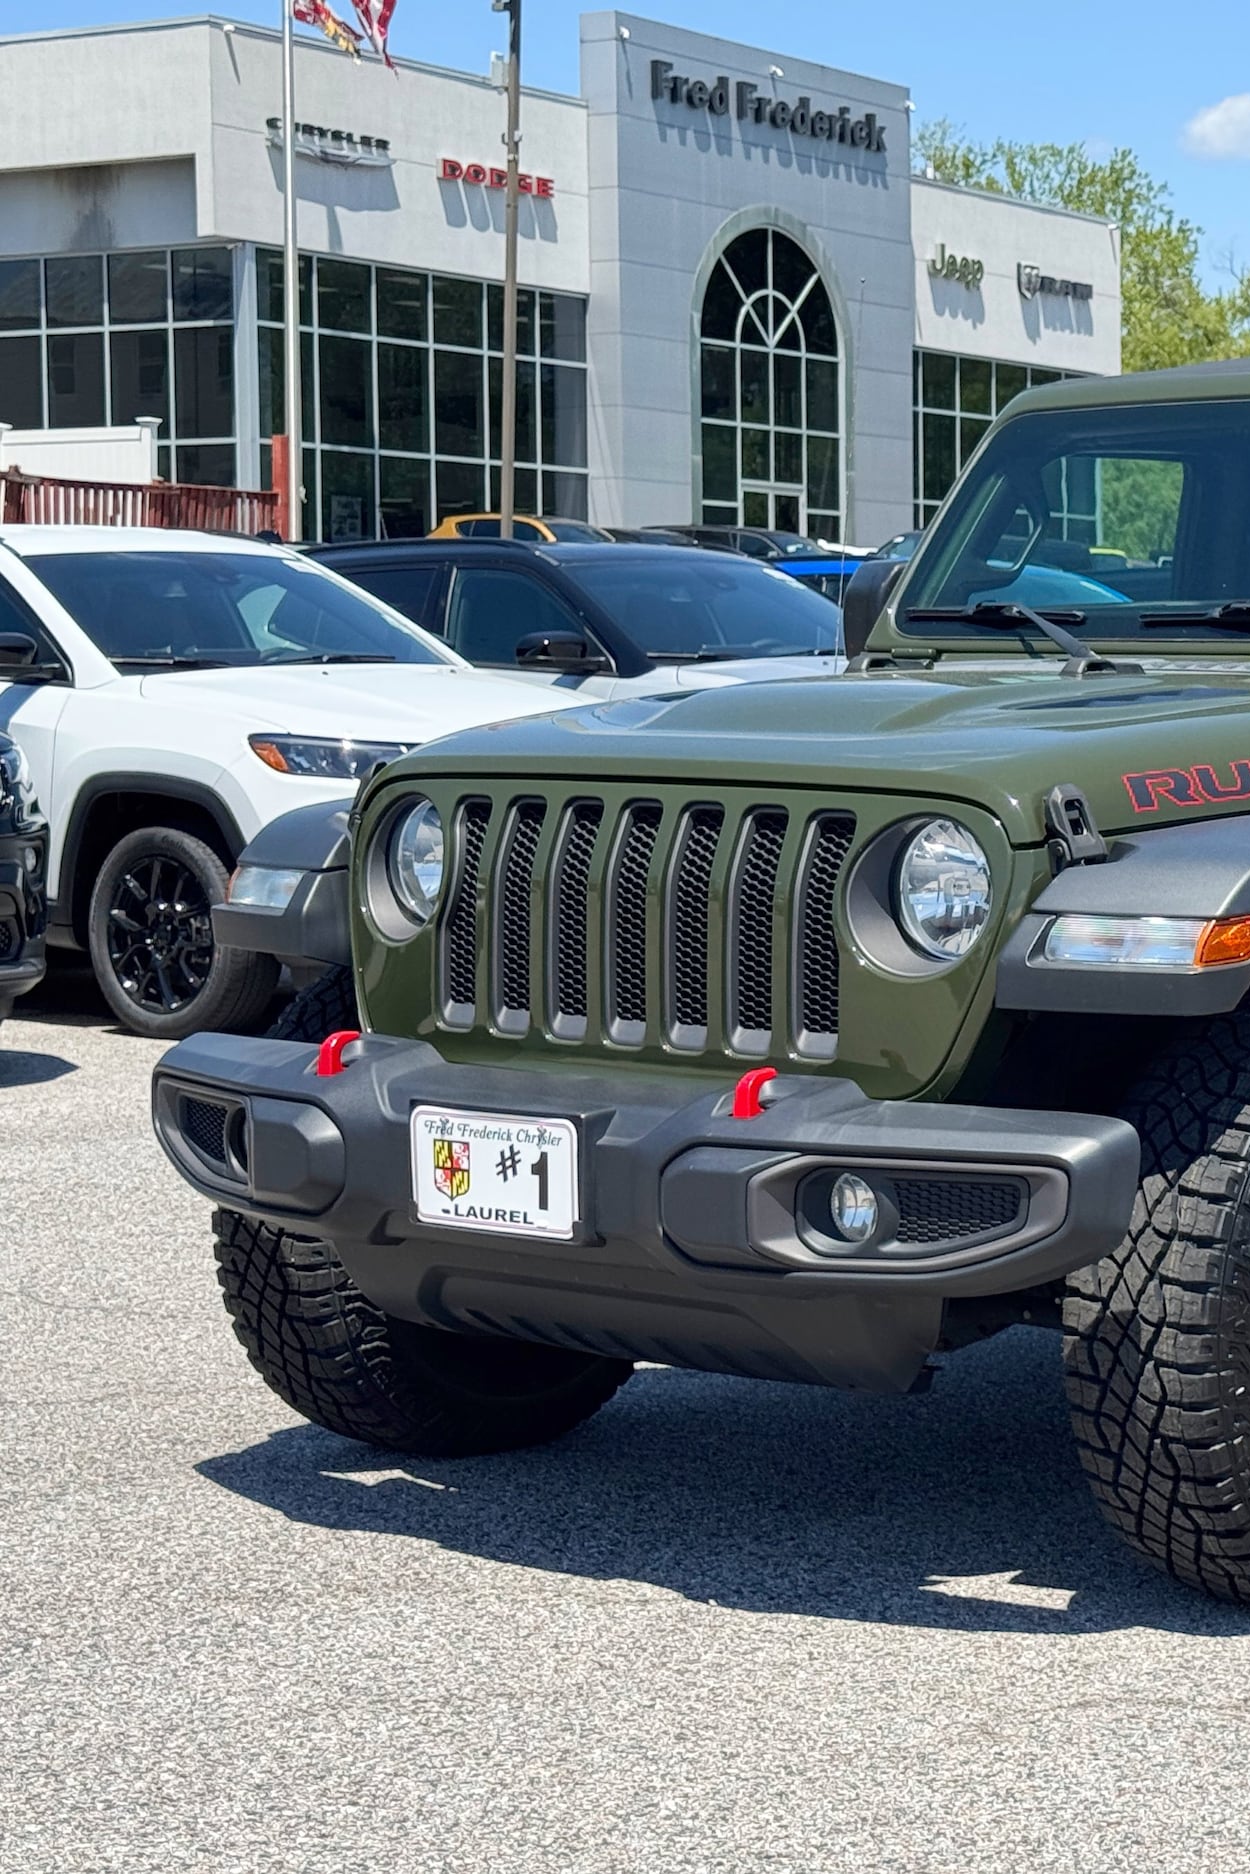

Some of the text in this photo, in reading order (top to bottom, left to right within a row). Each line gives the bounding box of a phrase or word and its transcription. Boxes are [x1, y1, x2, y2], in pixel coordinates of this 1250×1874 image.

[651, 60, 887, 151] Fred Frederick
[438, 158, 554, 198] DODGE
[927, 243, 984, 290] Jeep
[424, 1119, 563, 1147] Fred Frederick Chrysler
